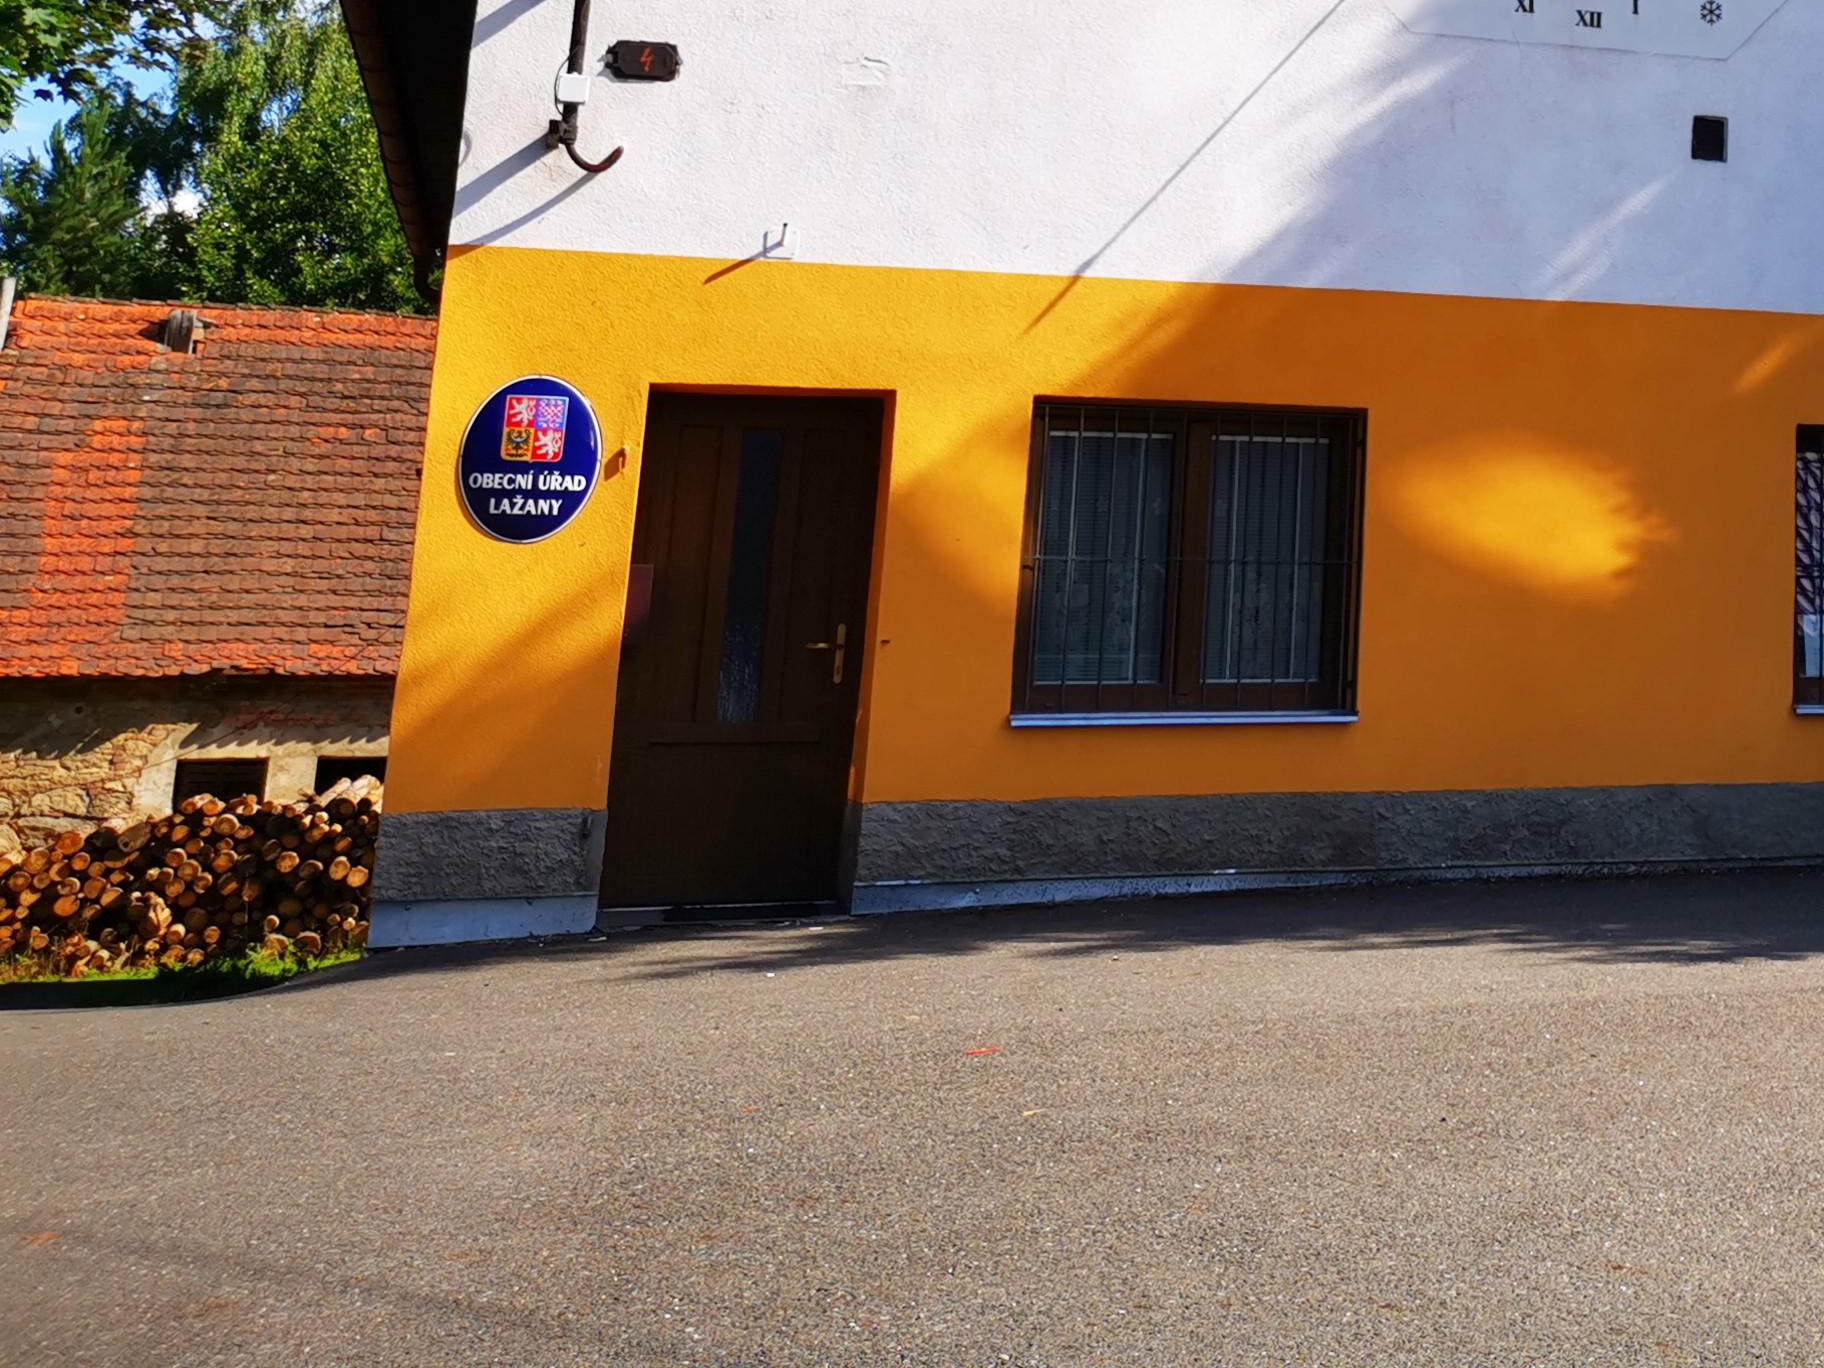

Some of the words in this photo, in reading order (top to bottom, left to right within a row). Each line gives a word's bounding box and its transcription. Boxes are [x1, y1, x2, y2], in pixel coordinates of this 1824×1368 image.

[1575, 9, 1602, 29] XII
[469, 470, 534, 490] OBECNÍ
[538, 470, 587, 492] ÚŘAD
[488, 494, 563, 516] LAŽANY
